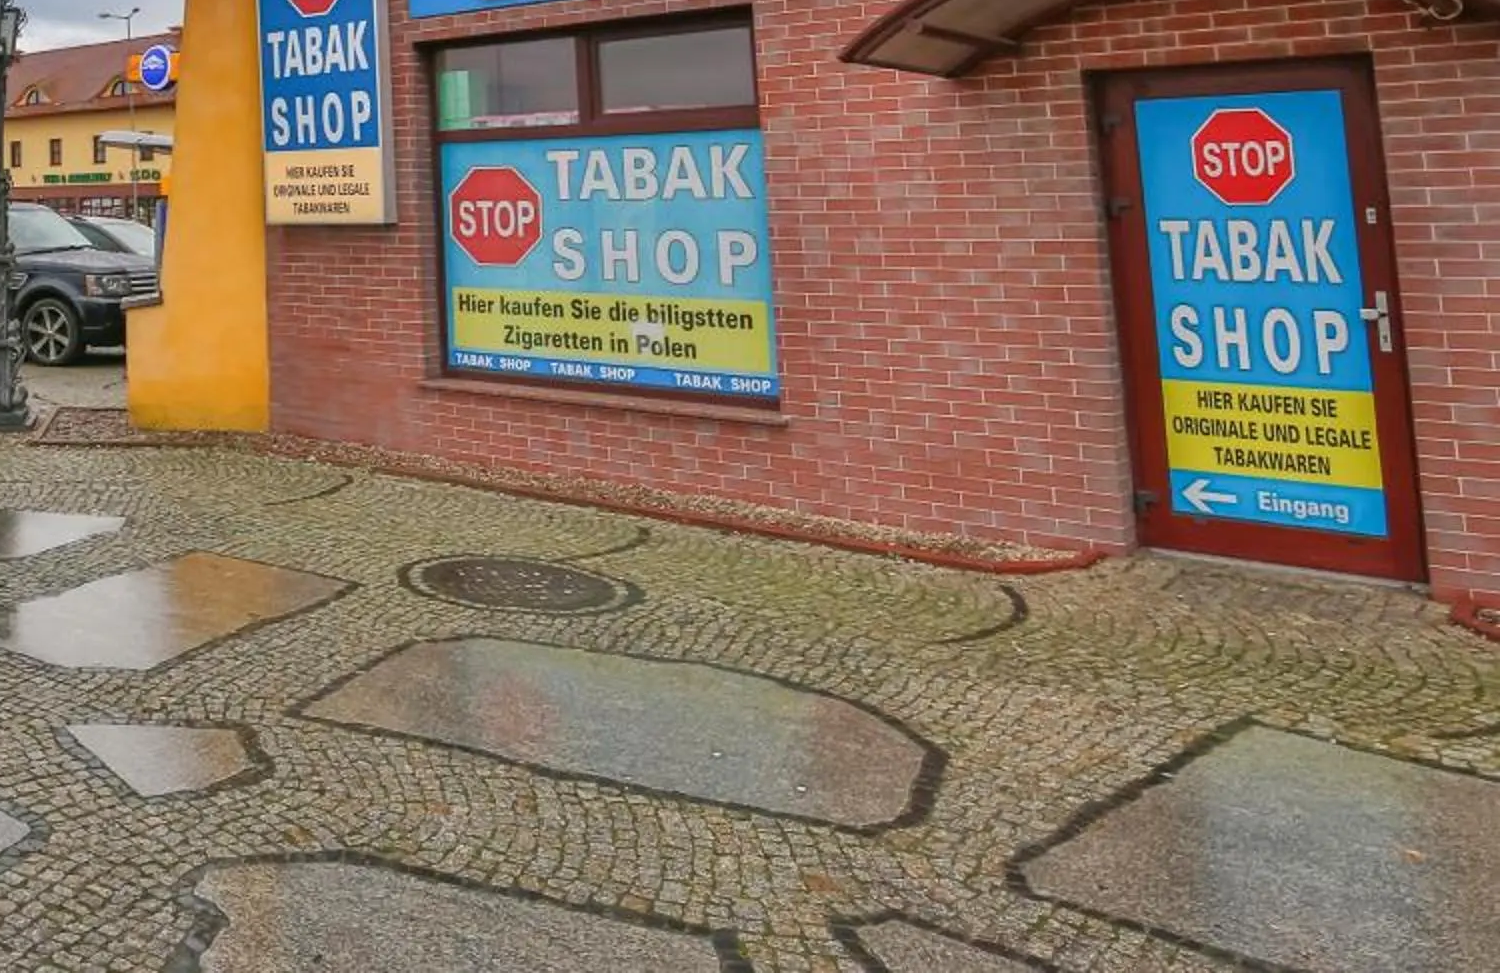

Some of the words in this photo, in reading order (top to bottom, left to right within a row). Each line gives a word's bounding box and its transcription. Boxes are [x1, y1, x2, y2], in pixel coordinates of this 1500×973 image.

[267, 20, 370, 78] TABAK
[271, 90, 371, 146] SHOP
[306, 165, 340, 178] KAUFEN
[546, 144, 755, 201] TABAK
[1203, 140, 1286, 178] STOP
[318, 183, 337, 196] UND
[338, 182, 370, 196] LEGALE
[459, 201, 535, 238] STOP
[552, 227, 758, 286] SHOP
[1159, 218, 1343, 284] TABAK
[458, 294, 494, 315] Hier
[500, 296, 564, 319] kaufen
[571, 299, 601, 320] Sie
[609, 301, 639, 322] die
[647, 303, 754, 331] biligstten
[504, 325, 603, 352] Zigaretten
[610, 333, 629, 354] in
[635, 334, 697, 360] Polen
[1170, 304, 1349, 375] SHOP
[455, 353, 493, 368] TABAK
[499, 356, 531, 371] SHOP
[550, 362, 592, 377] TABAK
[599, 366, 635, 380] SHOP
[674, 373, 722, 389] TABAK
[731, 378, 771, 393] SHOP
[1197, 390, 1233, 410] HIER
[1238, 393, 1306, 415] KAUFEN
[1311, 398, 1337, 418] SIE
[1172, 416, 1258, 440] ORIGINALE
[1263, 423, 1300, 444] UND
[1305, 426, 1372, 450] LEGALE
[1213, 446, 1331, 476] TABAKWAREN
[1257, 490, 1349, 524] Eingang
